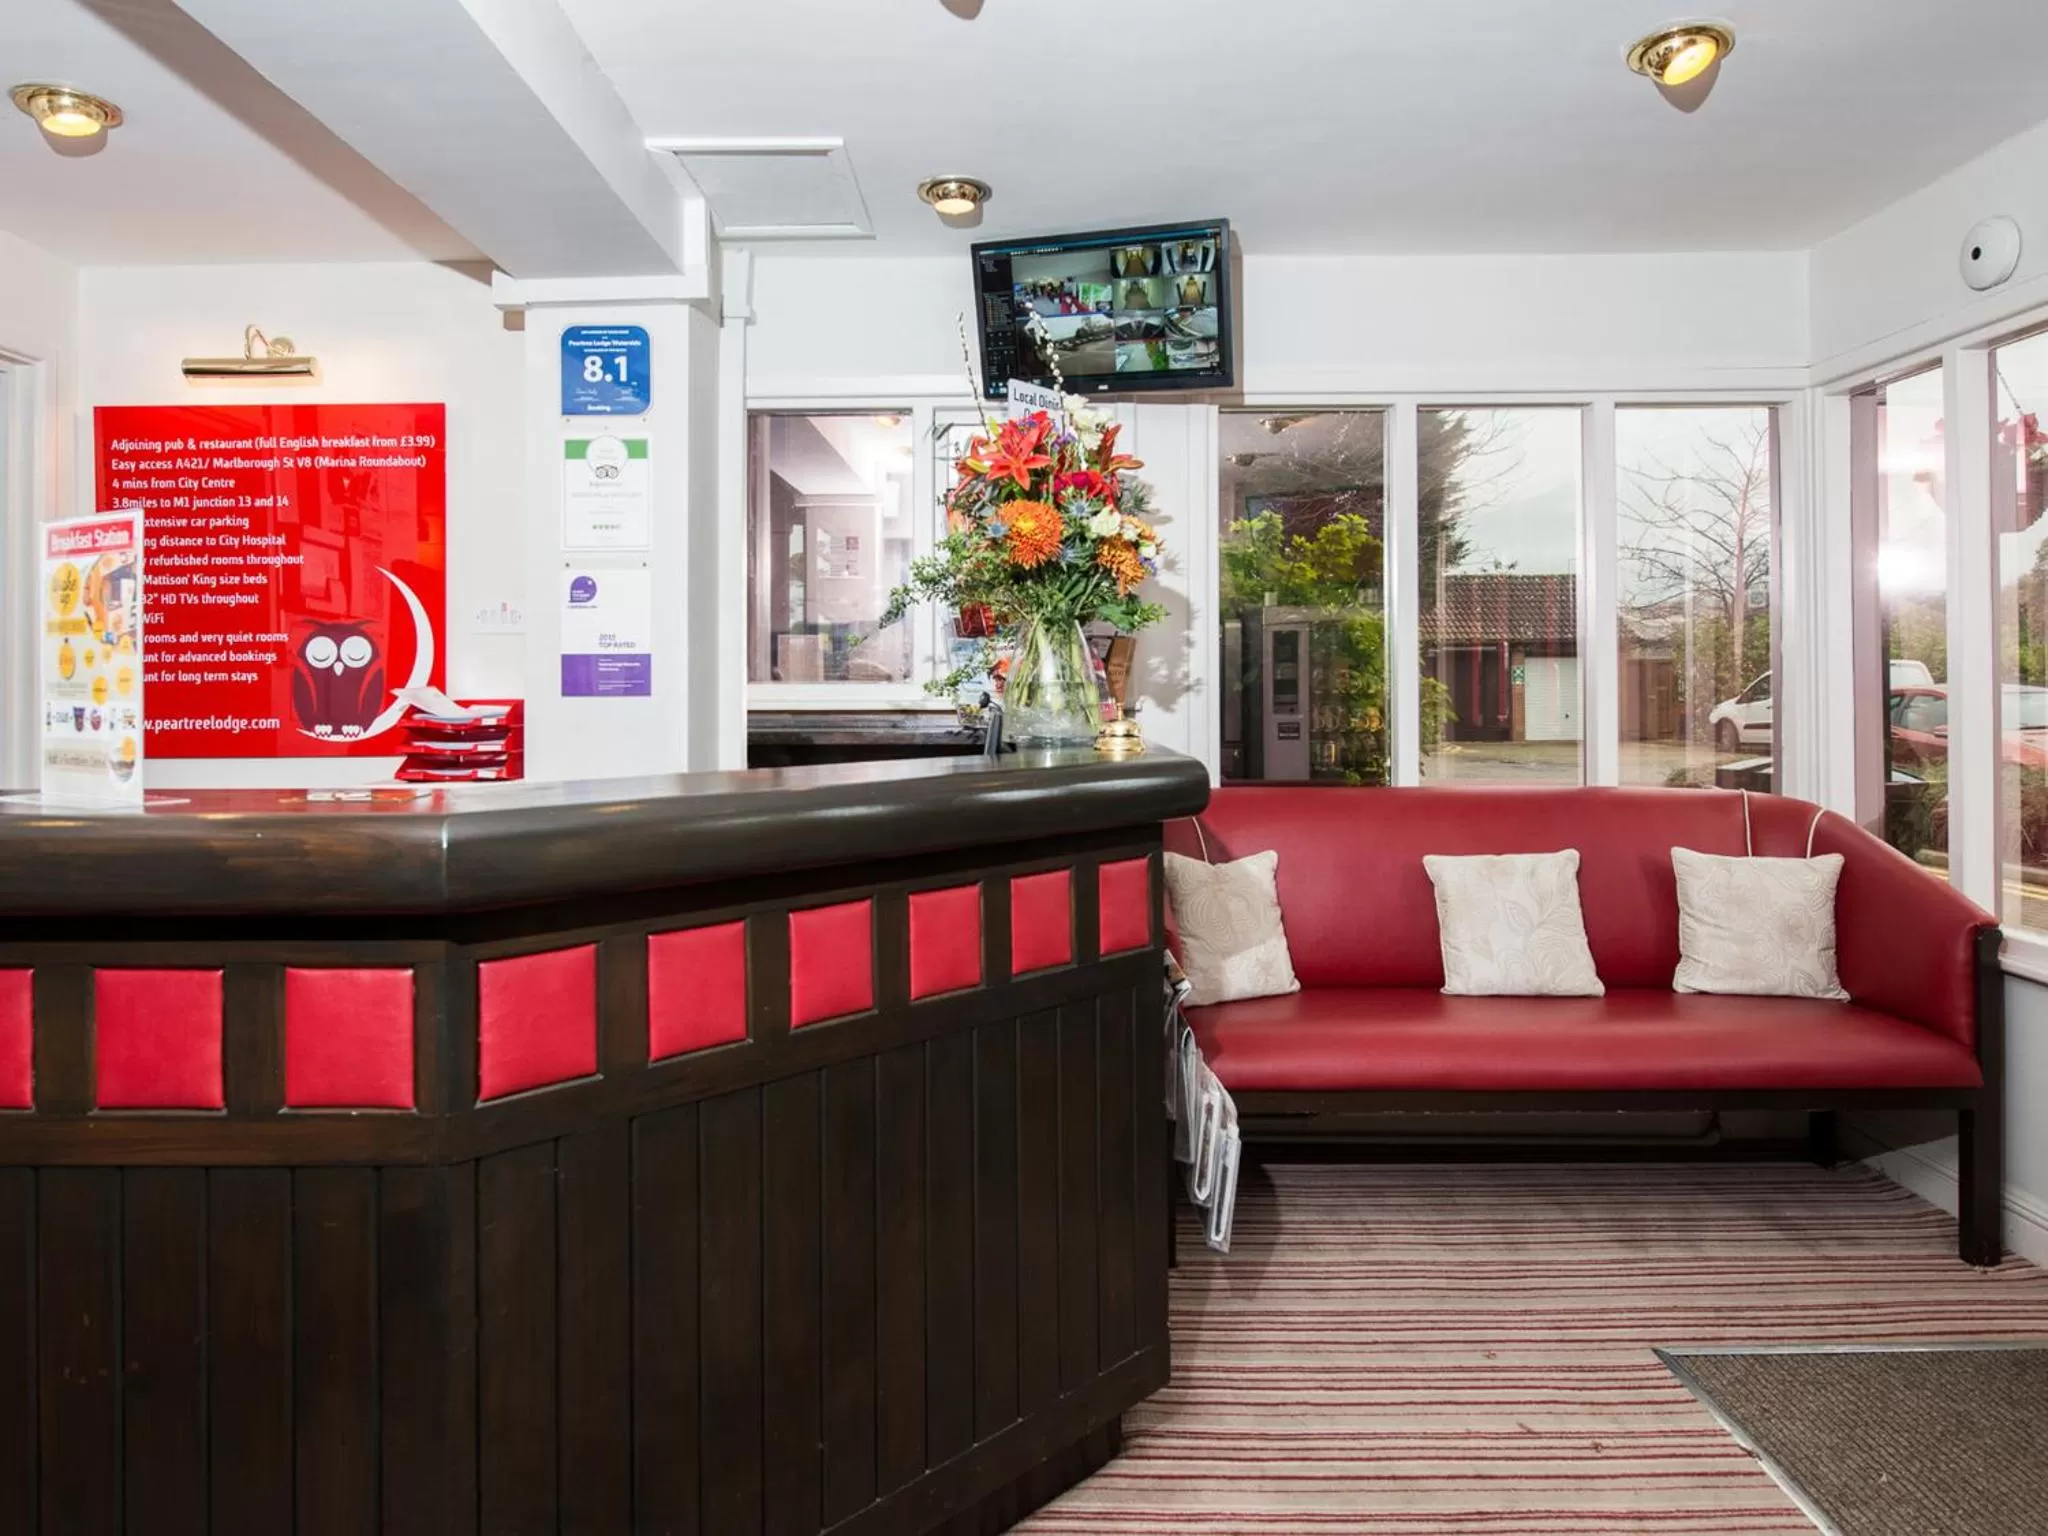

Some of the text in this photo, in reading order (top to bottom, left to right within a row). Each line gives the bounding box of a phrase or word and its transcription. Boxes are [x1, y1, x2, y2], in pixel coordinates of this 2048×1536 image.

[583, 355, 628, 383] 8.1
[1014, 387, 1037, 406] Local
[111, 435, 435, 453] Adjoining pub & restaurant (full English breakfast from £3.99)
[111, 454, 426, 472] Easy access A421/ Marlborough St V8 (Marina Roundabout)
[112, 476, 236, 491] 4 mins from City Centre
[160, 497, 171, 508] to
[173, 496, 190, 508] M1
[192, 496, 236, 511] junction
[238, 496, 251, 507] 13
[254, 495, 274, 507] and
[276, 495, 289, 507] 14
[143, 514, 249, 530] xtensive car parking
[51, 530, 93, 553] Breakfast
[94, 526, 130, 548] Station
[159, 535, 202, 547] distance
[205, 535, 217, 546] to
[219, 534, 240, 549] City
[242, 533, 286, 548] Hospital
[149, 554, 209, 566] refurbished
[211, 554, 244, 565] rooms
[246, 553, 304, 568] throughout
[192, 573, 217, 588] King
[219, 573, 240, 585] size
[242, 572, 268, 584] beds
[161, 593, 177, 605] HD
[178, 593, 199, 605] TVs
[201, 592, 259, 607] throughout
[144, 630, 289, 645] rooms and very quiet rooms
[161, 651, 176, 662] for
[178, 651, 227, 662] advanced
[229, 650, 277, 664] bookings
[161, 670, 176, 682] for
[178, 670, 201, 684] long
[203, 671, 229, 682] term
[231, 671, 258, 684] stays
[143, 715, 281, 734] w.peartreelodge.com
